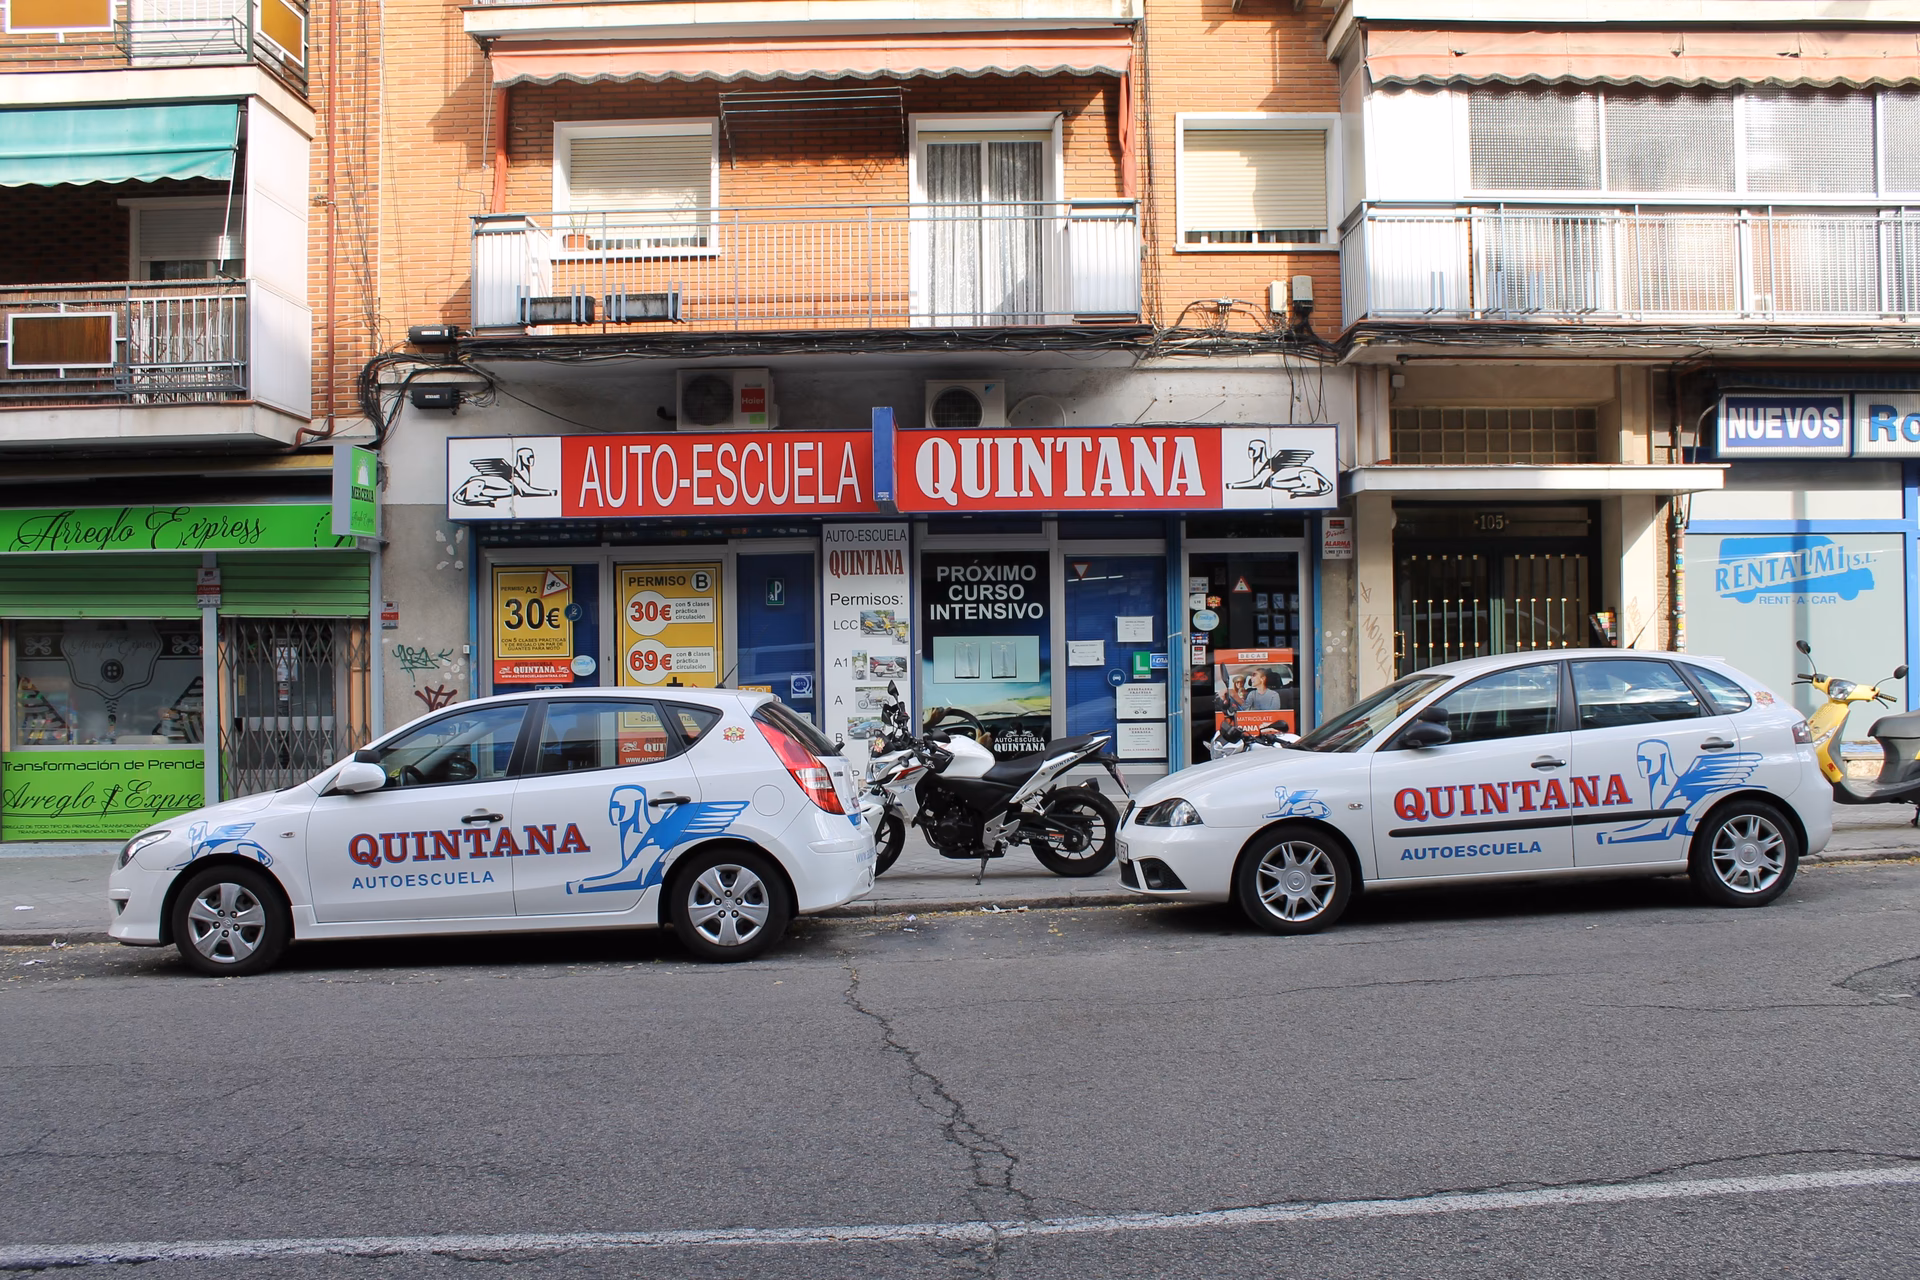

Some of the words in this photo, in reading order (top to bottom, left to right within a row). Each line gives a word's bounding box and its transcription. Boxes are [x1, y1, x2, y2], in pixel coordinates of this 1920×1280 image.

[1728, 406, 1840, 440] NUEVOS
[579, 441, 862, 508] AUTO-ESCUELA
[915, 436, 1206, 506] QUINTANA
[10, 507, 135, 551] Arreglo
[145, 506, 266, 550] Express
[1480, 514, 1504, 530] 105
[826, 529, 907, 542] AUTO-ESCUELA
[829, 550, 904, 579] QUINTANA
[936, 559, 1037, 582] PRÓXIMO
[1715, 546, 1844, 592] RENTALMI
[1853, 552, 1877, 566] S.L.
[628, 575, 686, 587] PERMISO
[696, 574, 708, 589] B
[829, 592, 904, 606] Permisos:
[948, 584, 1025, 601] CURSO
[503, 598, 560, 630] 30€
[630, 601, 672, 622] 30€
[930, 602, 1044, 620] INTENSIVO
[833, 619, 859, 631] LCC
[513, 666, 555, 674] QUINTANA
[629, 650, 673, 672] 69€
[833, 658, 848, 667] A1
[1135, 655, 1149, 671] L
[834, 696, 843, 705] A
[835, 732, 843, 743] B
[993, 743, 1046, 752] QUINTANA
[2, 759, 120, 771] Transformación
[124, 760, 144, 770] de
[1049, 754, 1079, 771] QUINTANA
[2, 781, 96, 818] Arreglo
[1393, 774, 1633, 822] QUINTANA
[348, 823, 591, 869] QUINTANA
[1400, 841, 1542, 861] AUTOESCUELA
[352, 871, 494, 889] AUTOESCUELA
